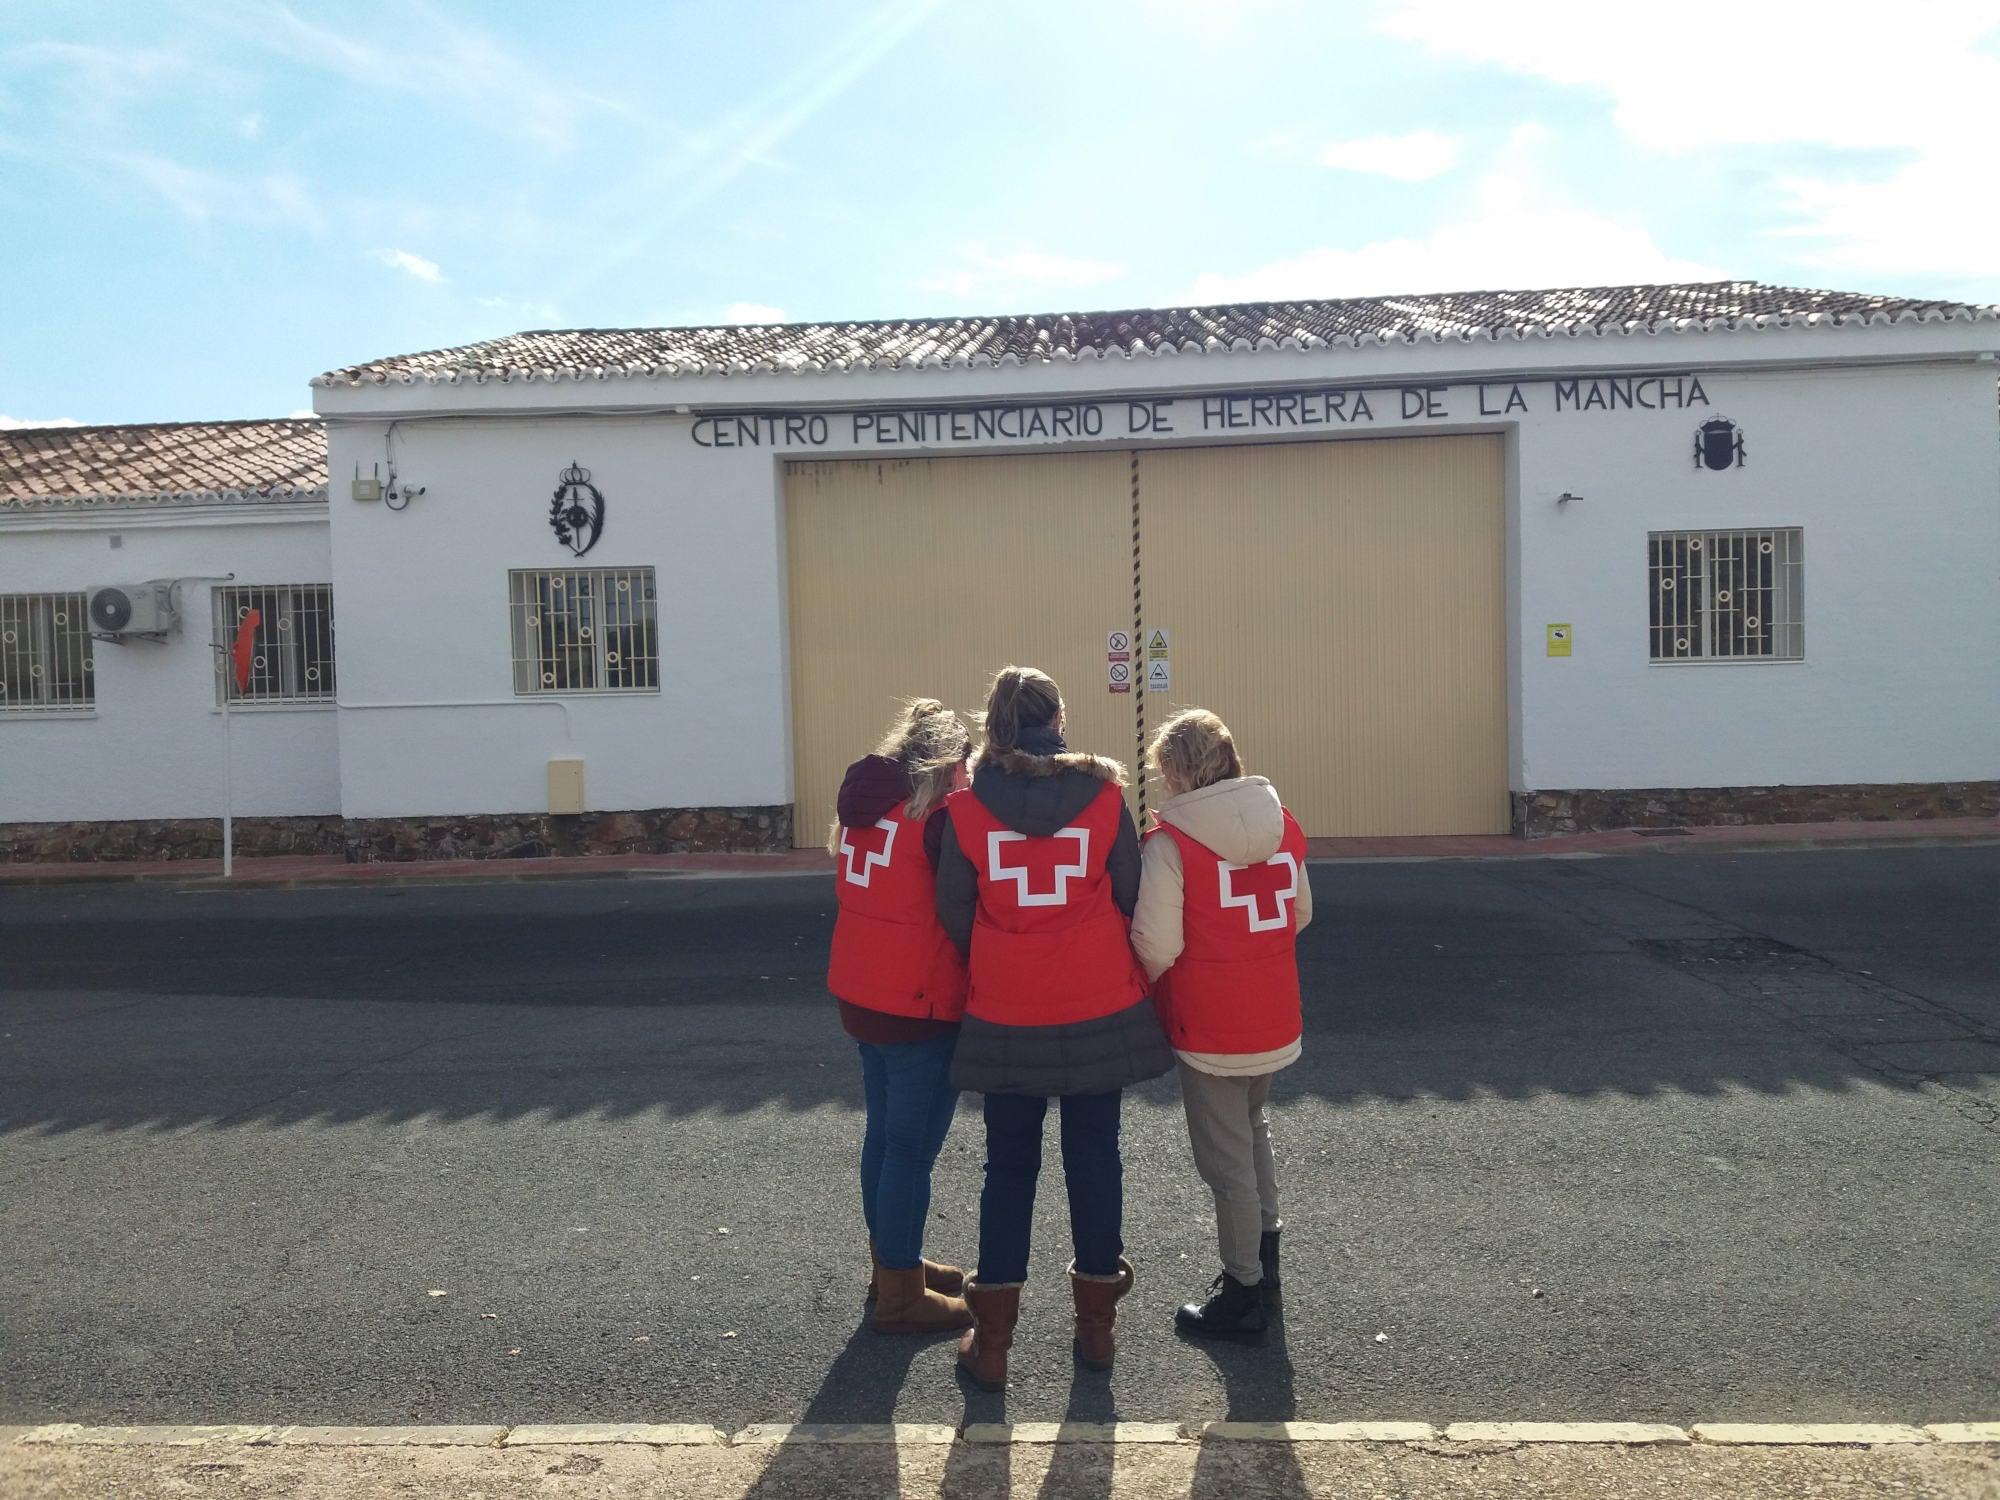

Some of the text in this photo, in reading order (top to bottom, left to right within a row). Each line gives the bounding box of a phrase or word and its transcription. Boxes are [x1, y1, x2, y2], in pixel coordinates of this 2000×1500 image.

[691, 378, 1710, 447] CENTRO PENITENCIARIO DE HERRERA DE LA MANCHA
